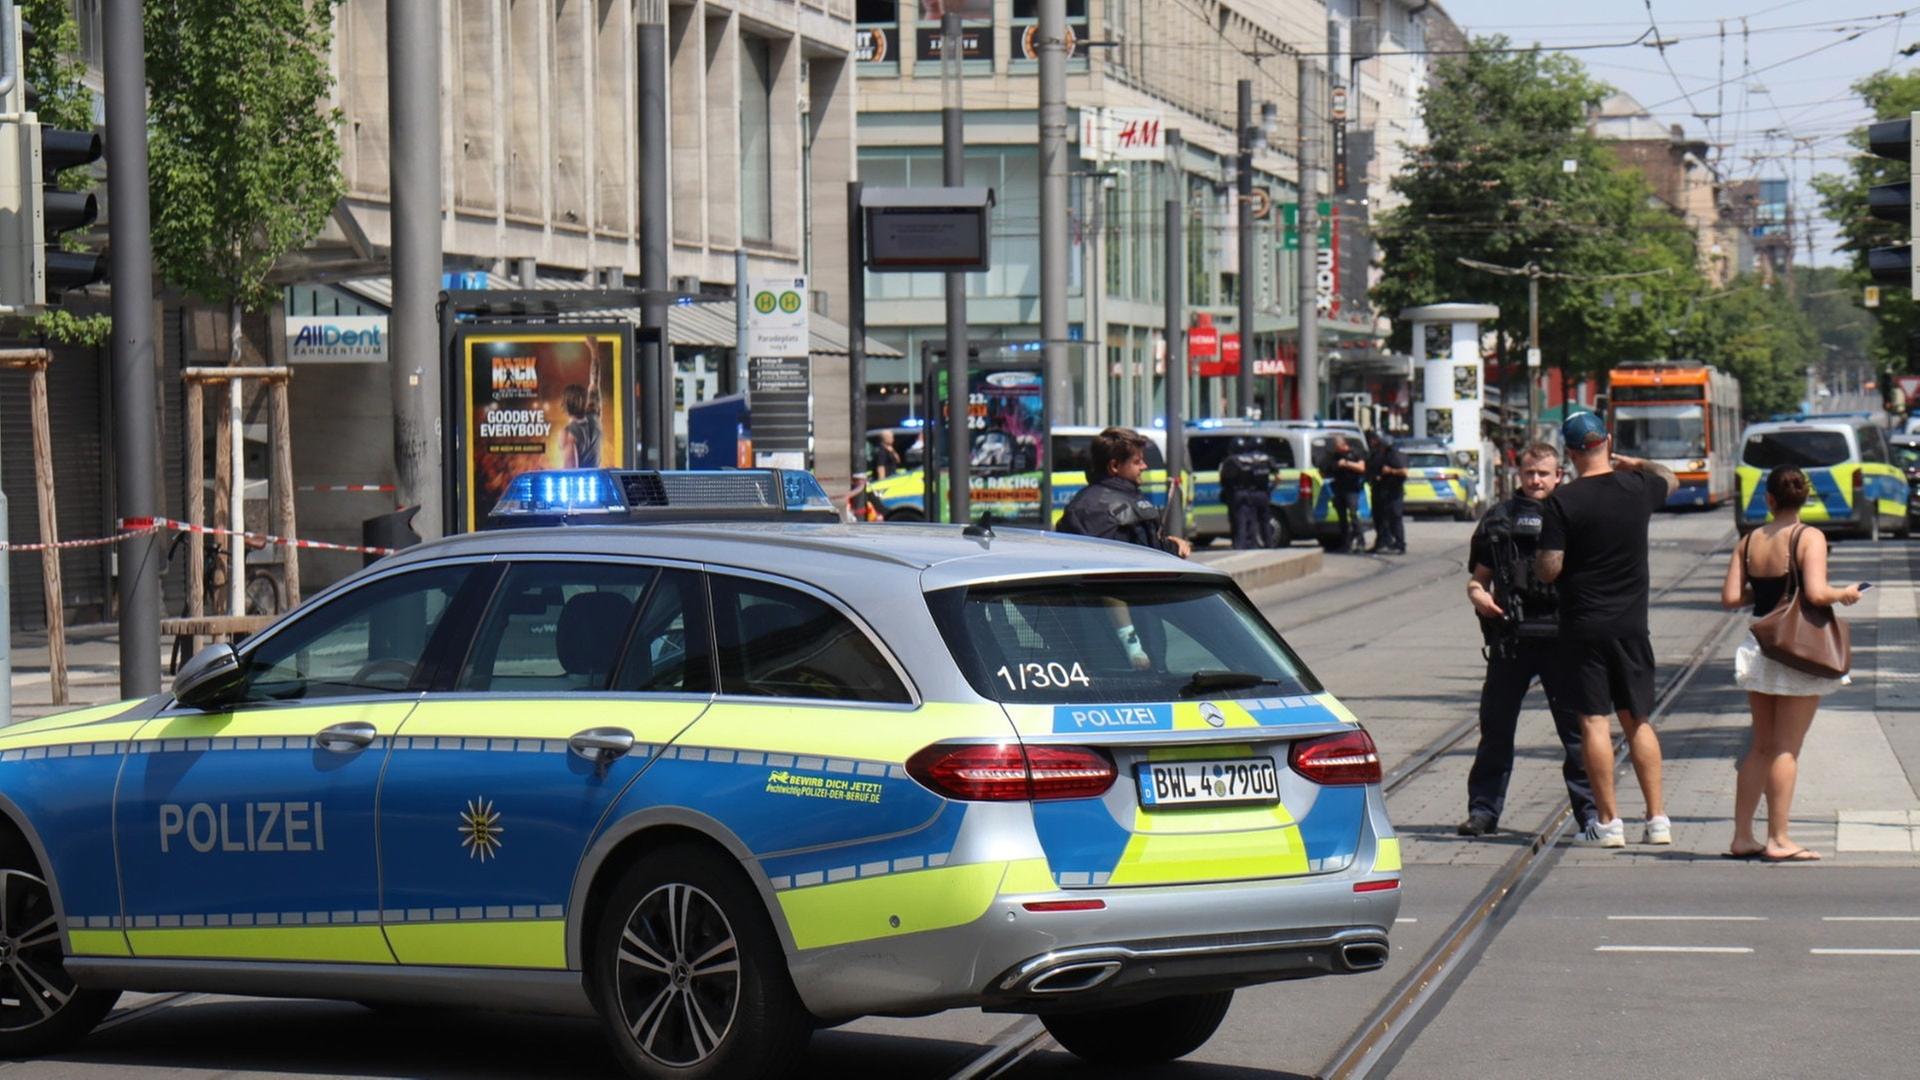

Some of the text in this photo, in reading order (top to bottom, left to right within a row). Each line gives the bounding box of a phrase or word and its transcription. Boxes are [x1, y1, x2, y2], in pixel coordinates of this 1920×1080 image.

[294, 324, 381, 346] AllDent
[294, 346, 381, 355] ZAHNZENTRUM
[1253, 360, 1286, 375] EMA
[487, 410, 544, 424] GOODBYE
[480, 423, 551, 437] EVERYBODY
[987, 477, 1039, 490] RACING
[997, 661, 1090, 692] 1/304
[1072, 707, 1158, 729] POLIZEI
[789, 775, 882, 793] BEWIRB DICH JETZT!
[1153, 765, 1197, 799] BWL
[159, 801, 325, 853] POLIZEI
